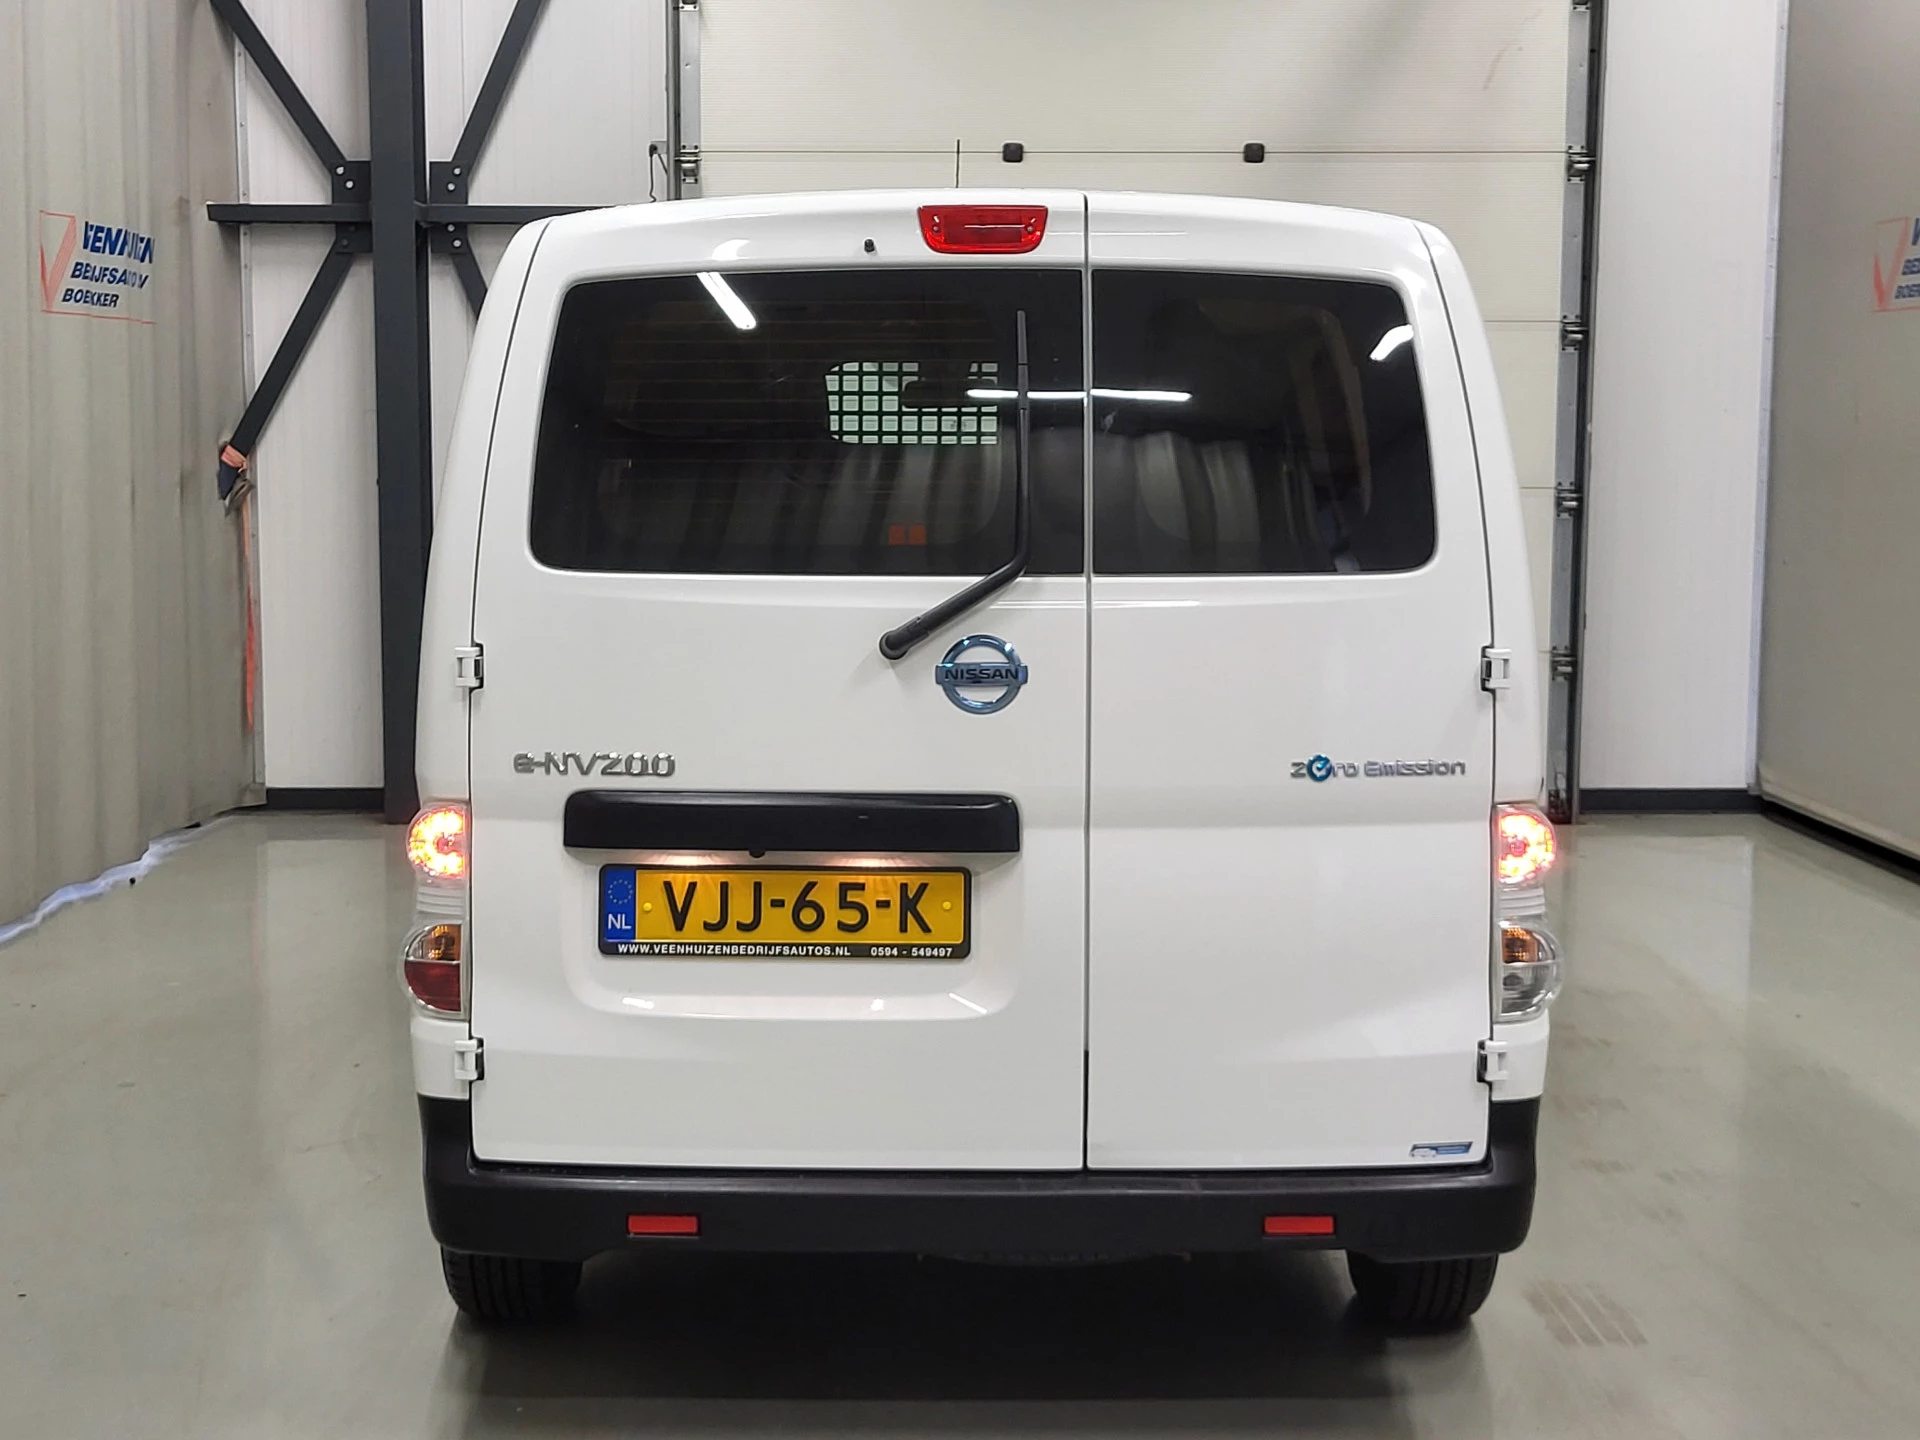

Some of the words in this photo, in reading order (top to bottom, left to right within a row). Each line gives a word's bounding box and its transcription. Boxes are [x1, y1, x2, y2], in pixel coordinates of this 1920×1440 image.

[944, 668, 1019, 680] NISSAN
[513, 751, 676, 777] e-NV200
[1363, 759, 1467, 777] Emission
[663, 881, 932, 934] VJJ-65-K
[607, 913, 632, 930] NL
[617, 943, 851, 957] WWW.VEENHUIZENBEDRIJFSAUTOS.NL
[870, 946, 898, 957] 0594
[911, 946, 953, 958] 549497
